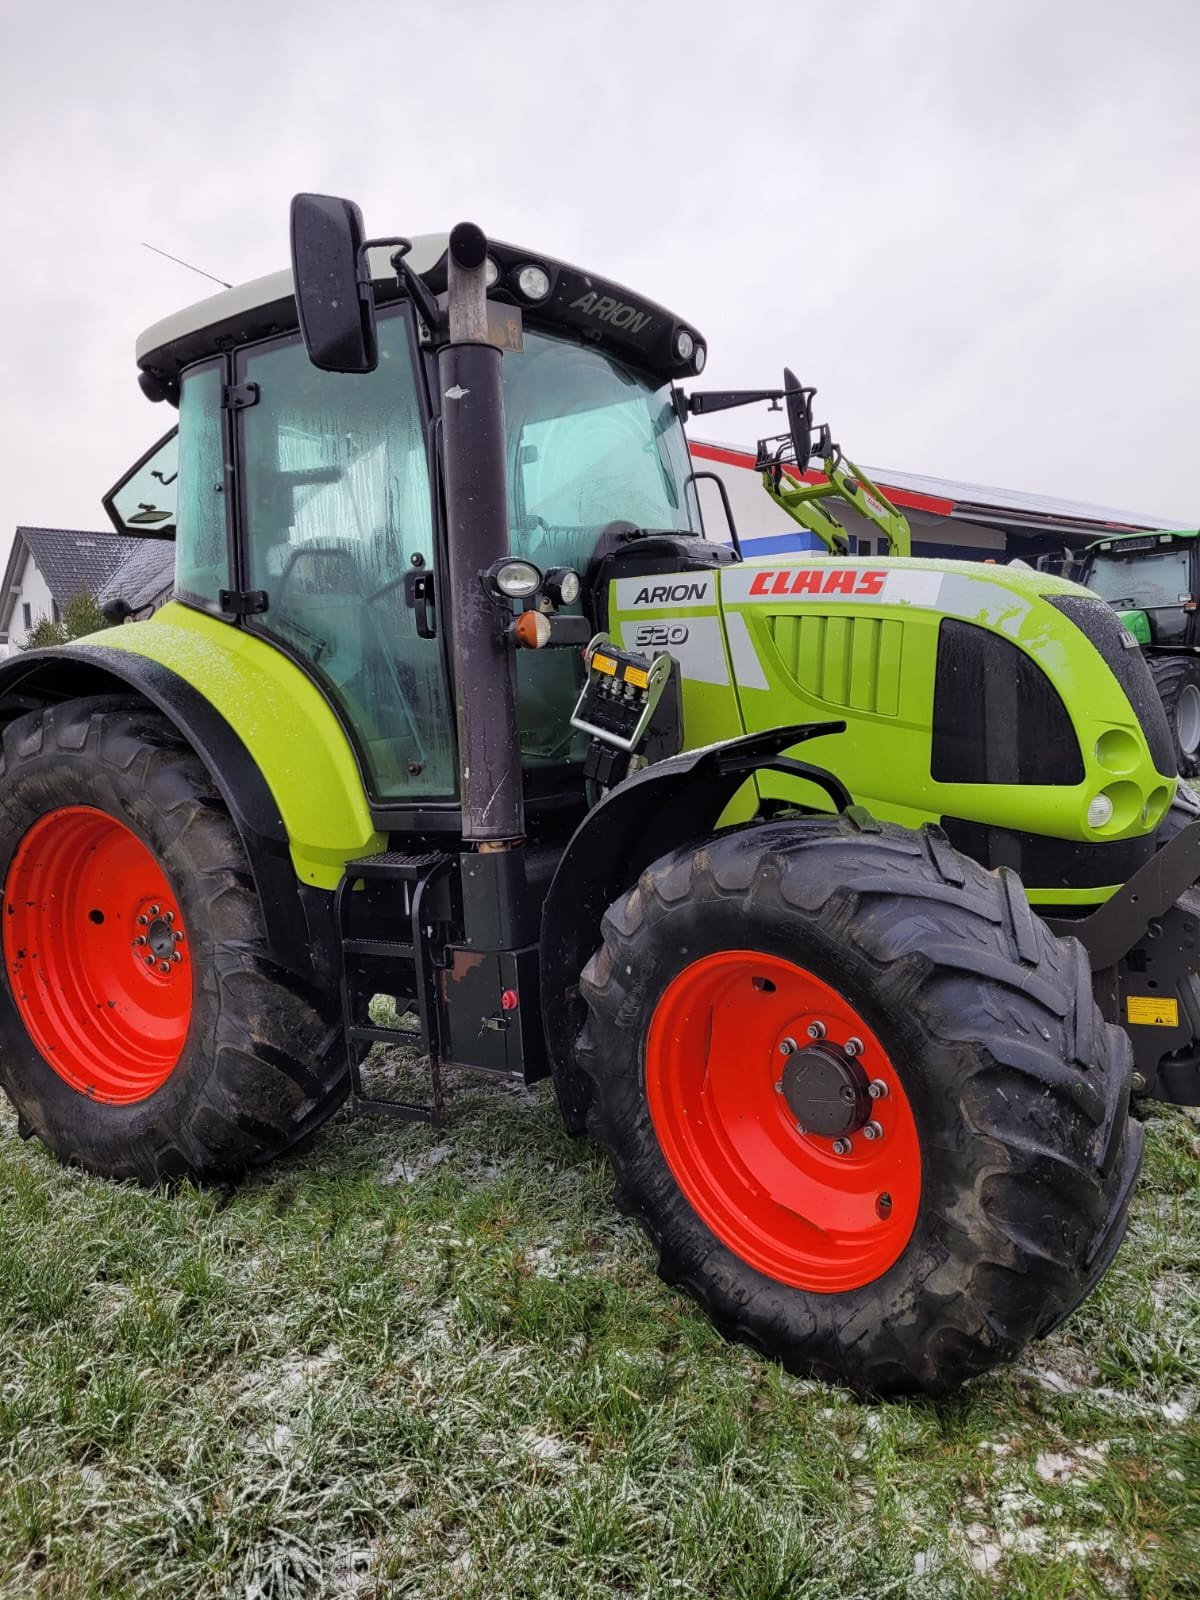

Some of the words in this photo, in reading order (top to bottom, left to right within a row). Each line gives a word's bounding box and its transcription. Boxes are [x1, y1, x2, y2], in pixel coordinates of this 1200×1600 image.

[568, 291, 652, 333] ARION
[633, 582, 708, 605] ARION
[749, 570, 888, 596] CLAAS
[635, 624, 689, 646] 520
